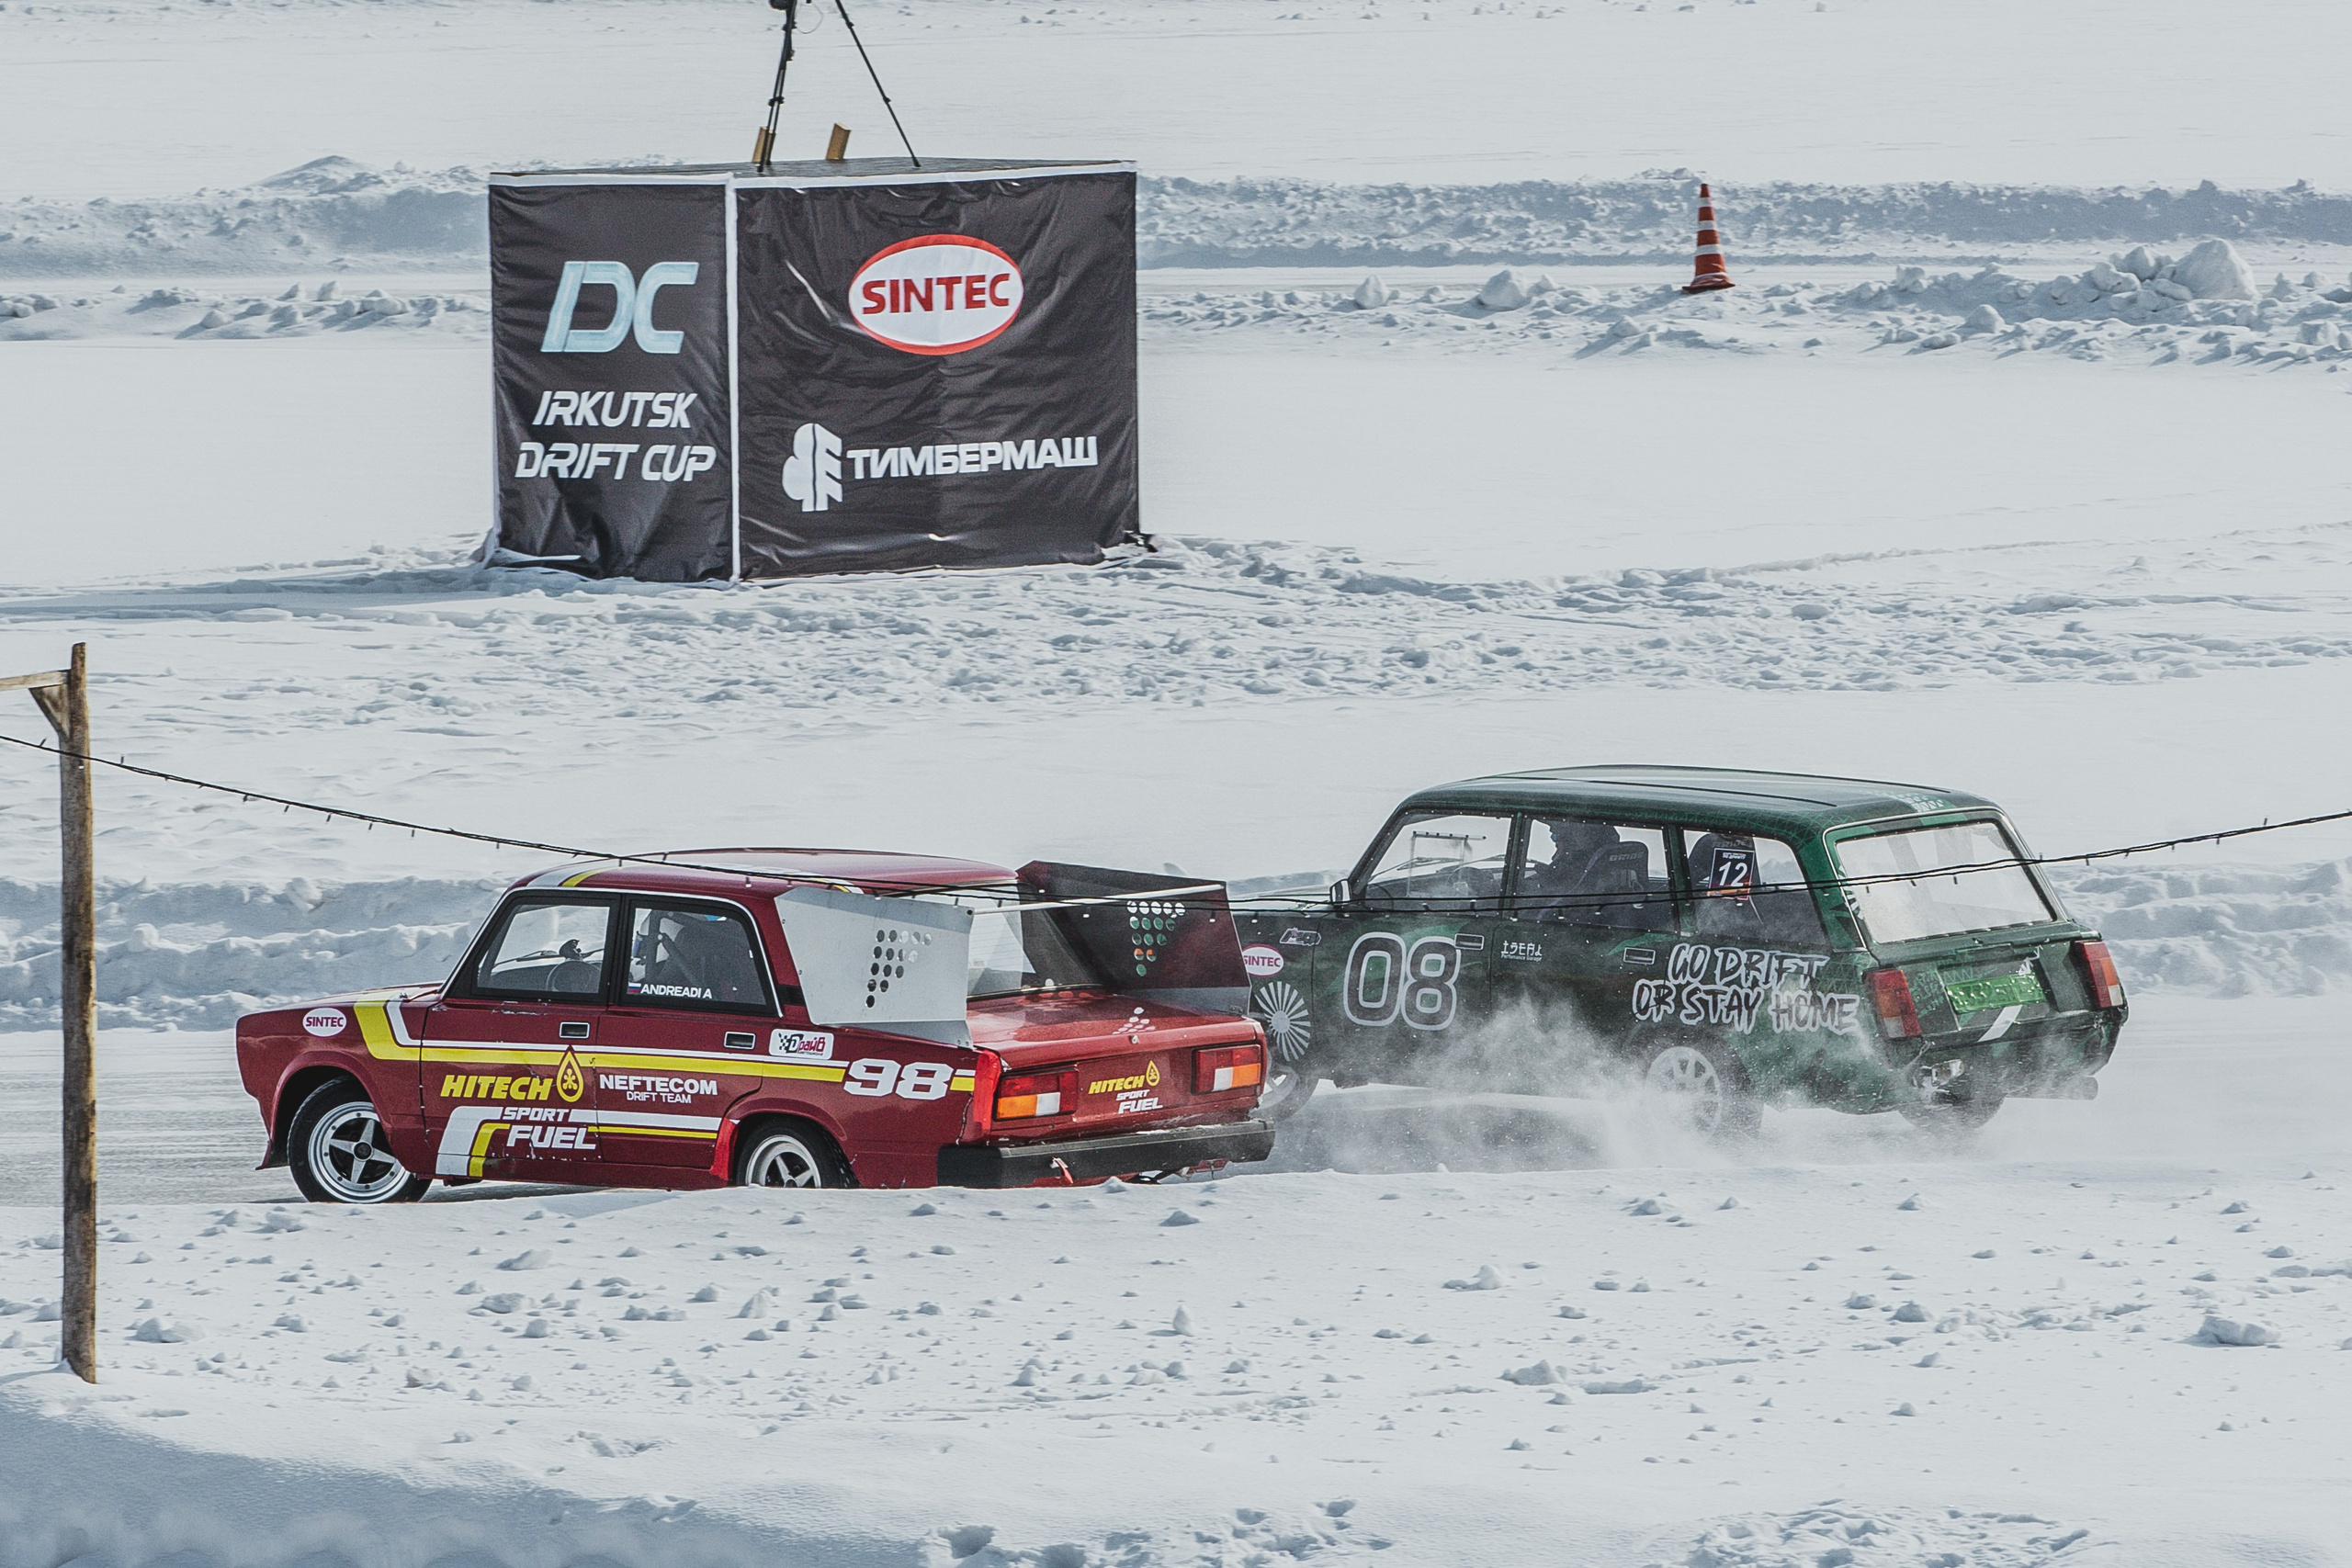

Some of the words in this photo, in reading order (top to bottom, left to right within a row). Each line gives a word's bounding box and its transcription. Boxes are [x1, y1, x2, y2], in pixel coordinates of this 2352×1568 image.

[862, 273, 1011, 314] SINTEC
[532, 390, 698, 429] IRKUTSK
[514, 442, 640, 479] DRIFT
[641, 445, 717, 482] CUP
[846, 435, 1098, 479] ТИМБЕРМАШ
[1718, 861, 1748, 887] 12
[1668, 942, 1711, 984] GO
[1713, 947, 1830, 989] DRIFT
[640, 983, 702, 998] ANDREADI
[702, 988, 713, 999] A
[1344, 932, 1462, 1031] 08
[1632, 978, 1676, 1023] OR
[1679, 982, 1765, 1035] STAY
[1767, 988, 1860, 1035] HOME
[305, 1016, 345, 1028] SINTEC
[440, 1074, 553, 1100] HITECH
[599, 1074, 718, 1096] NEFTECOM
[842, 1058, 954, 1100] 98
[1088, 1075, 1146, 1095] HITECH
[627, 1090, 658, 1102] DRIFT
[662, 1092, 692, 1104] TEAM
[1115, 1089, 1150, 1101] SPORT
[1118, 1097, 1164, 1115] FUEL
[503, 1106, 570, 1122] SPORT
[506, 1124, 597, 1150] FUEL
